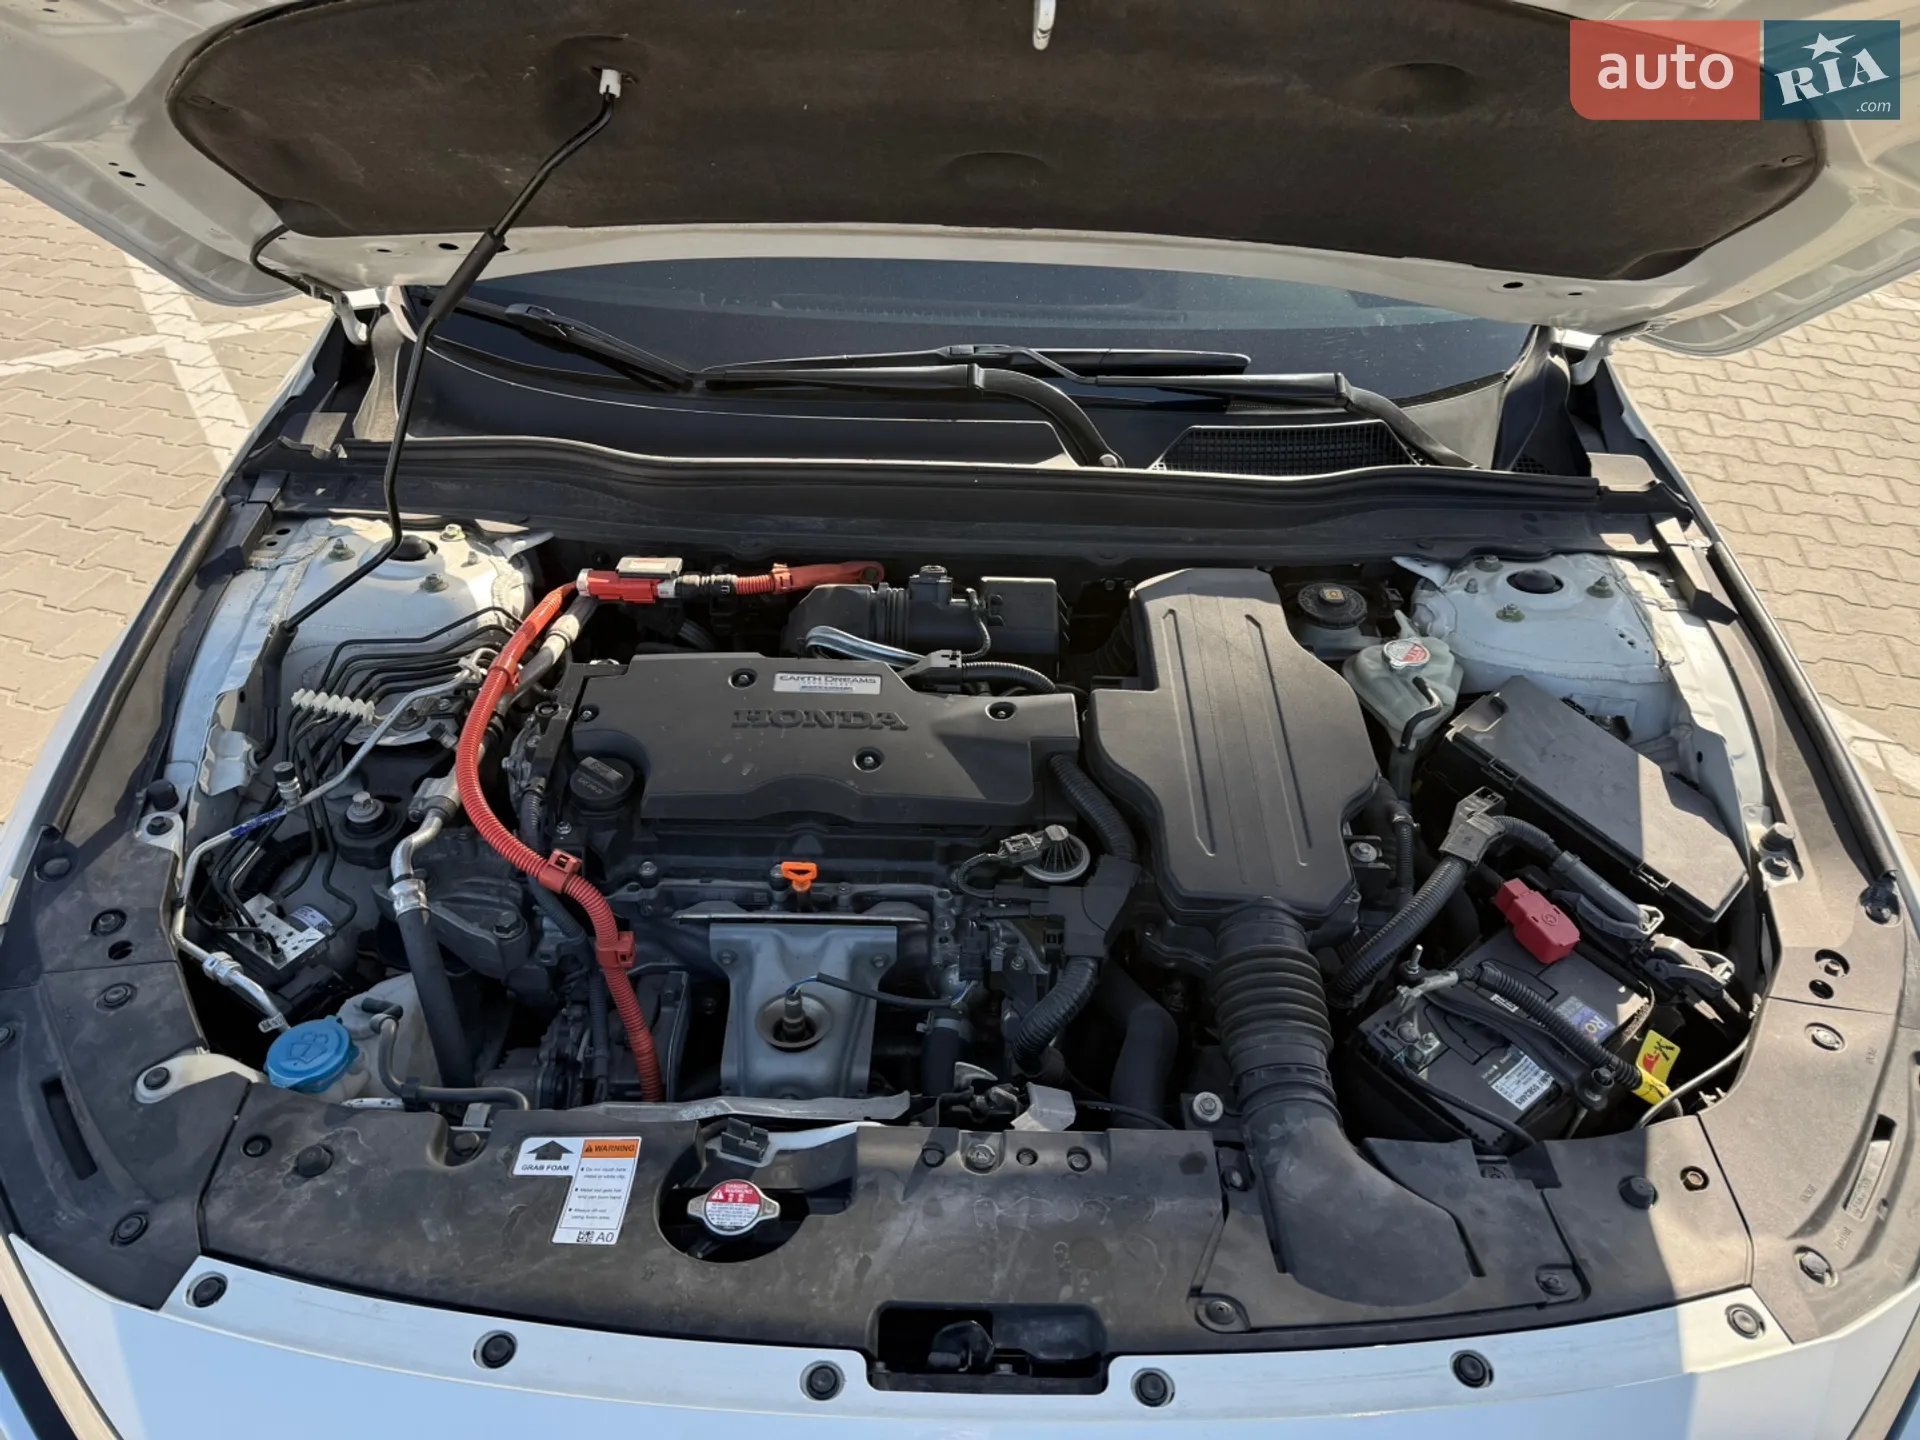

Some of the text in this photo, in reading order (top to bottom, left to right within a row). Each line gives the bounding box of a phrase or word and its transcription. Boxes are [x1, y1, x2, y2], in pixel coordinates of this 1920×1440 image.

[824, 675, 877, 684] DREAMS
[731, 709, 909, 731] HONDA
[594, 1144, 637, 1152] WARNING
[595, 1232, 615, 1243] A0
